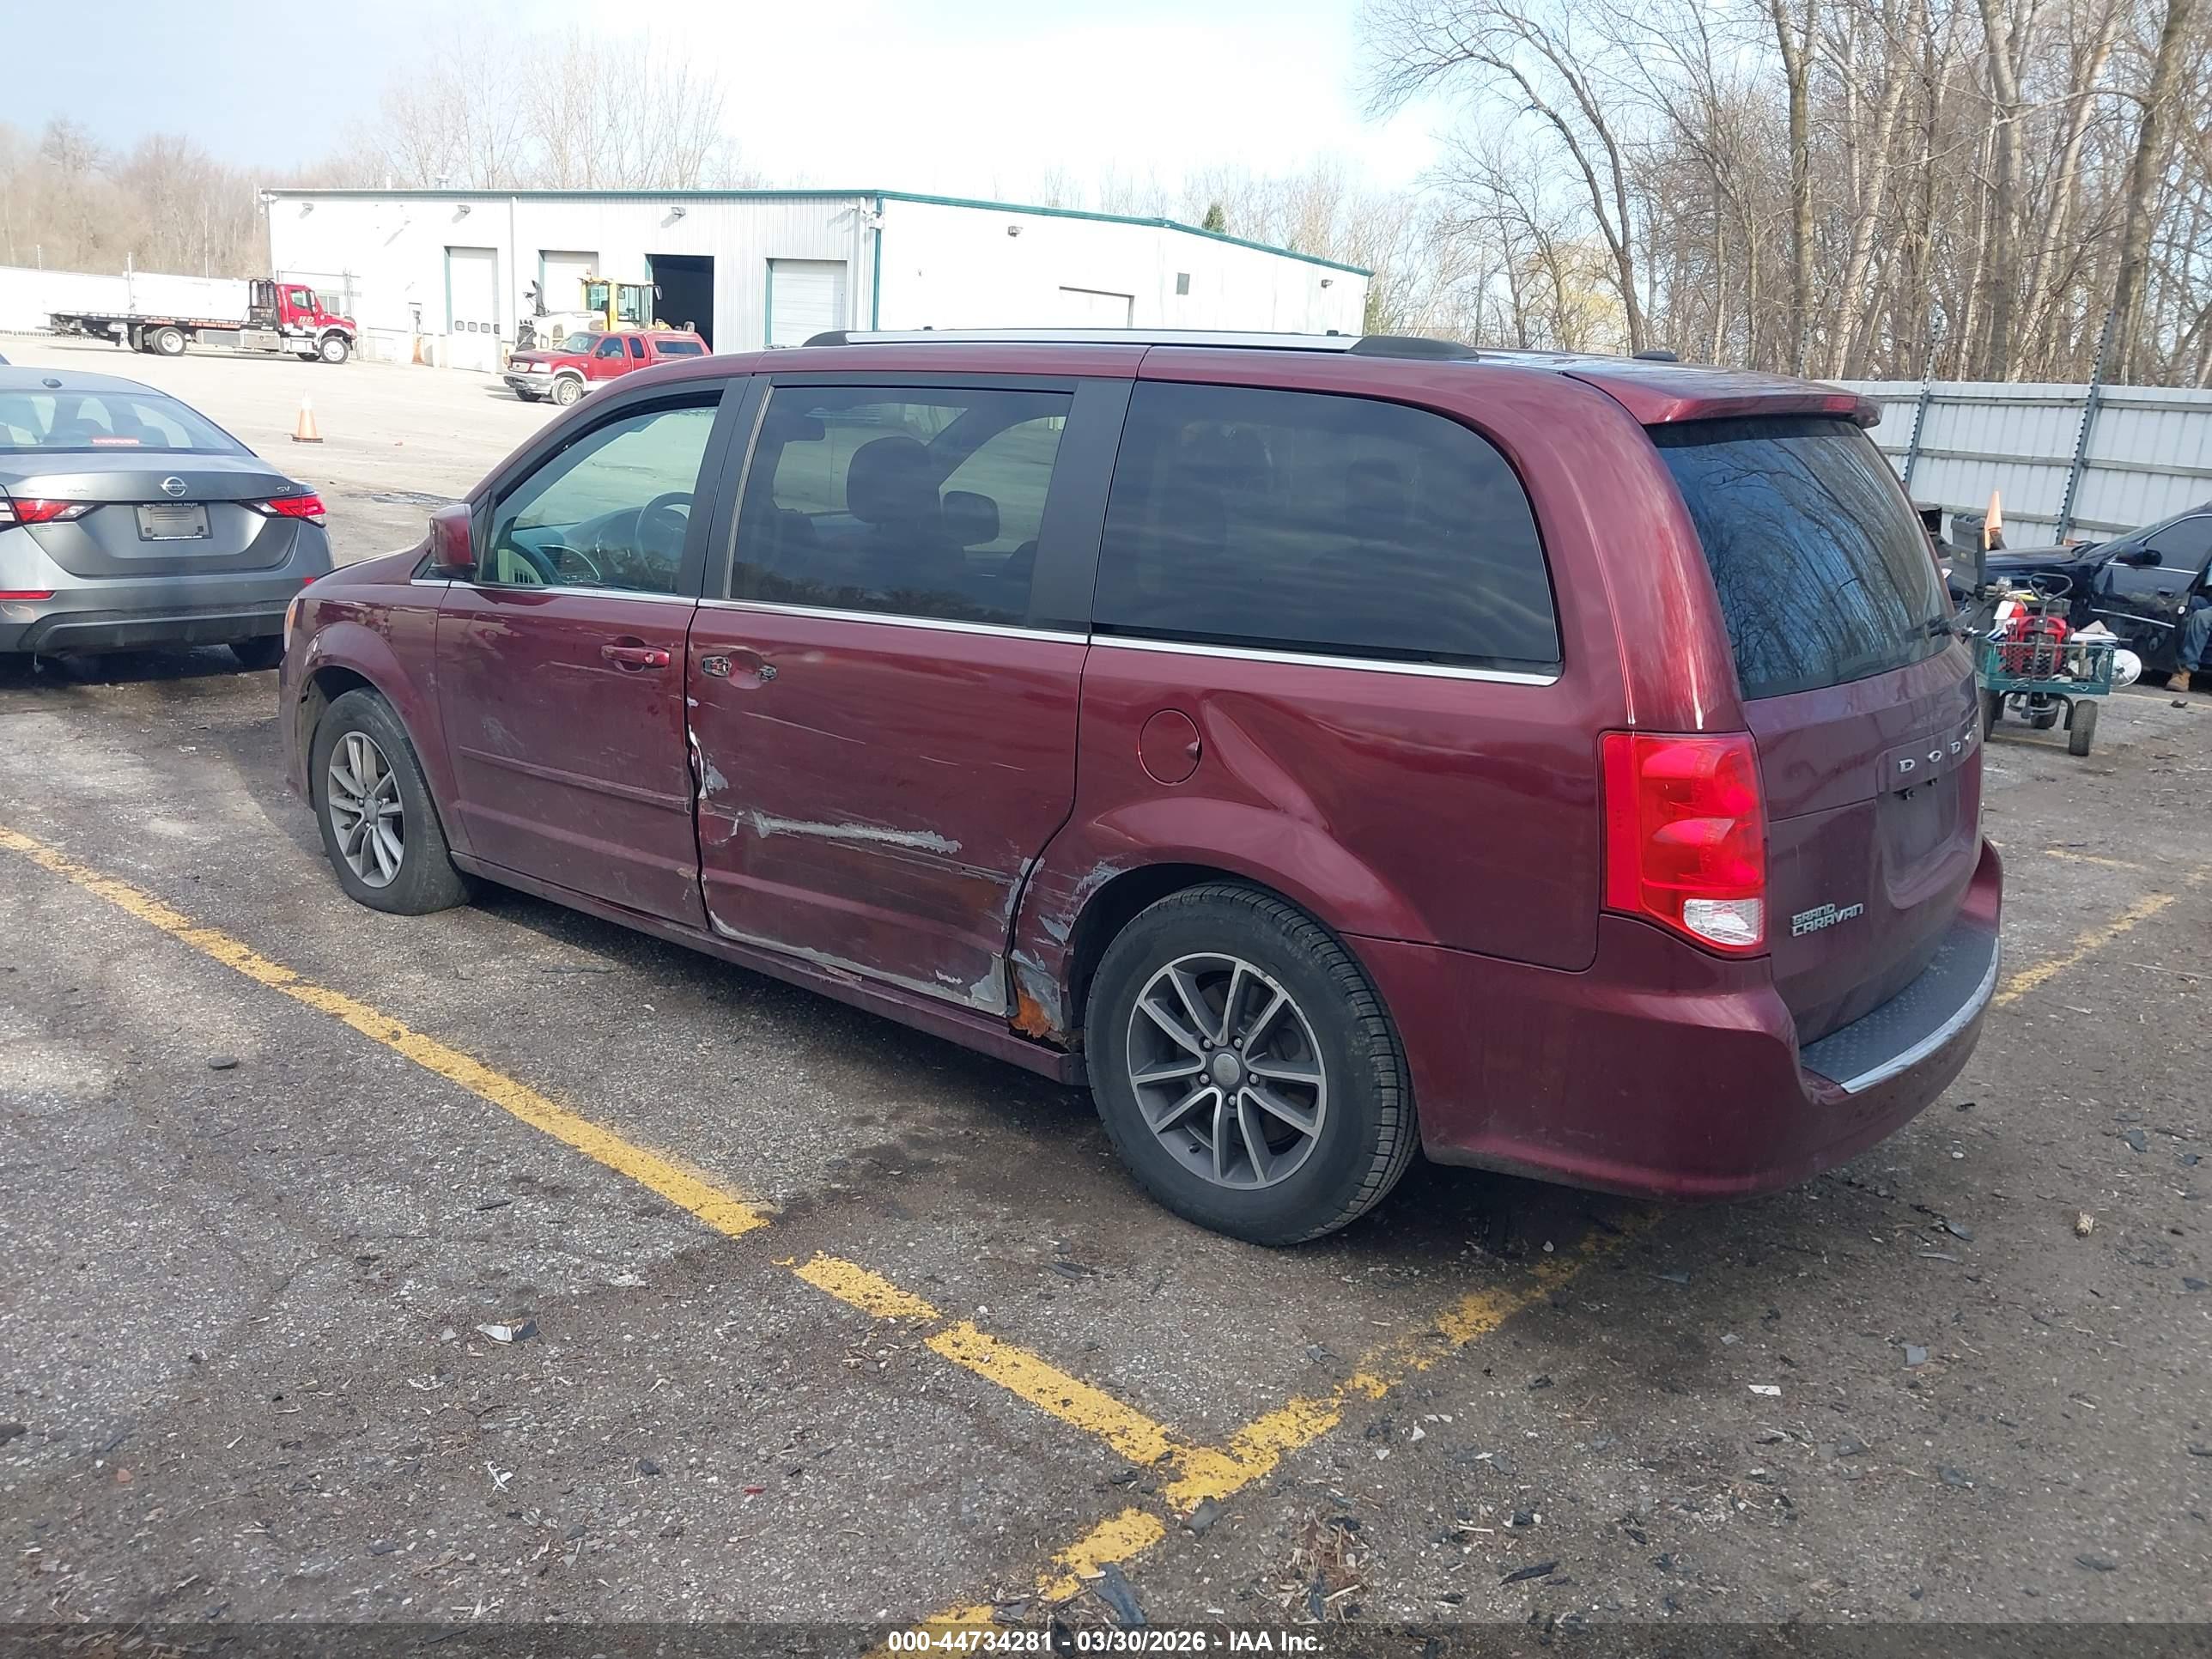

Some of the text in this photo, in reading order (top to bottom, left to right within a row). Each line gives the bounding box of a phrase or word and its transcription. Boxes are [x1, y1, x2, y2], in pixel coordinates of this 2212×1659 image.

[1898, 721, 1979, 773] DOD
[1791, 902, 1836, 926] GRAND
[1791, 902, 1864, 937] CARAVAN
